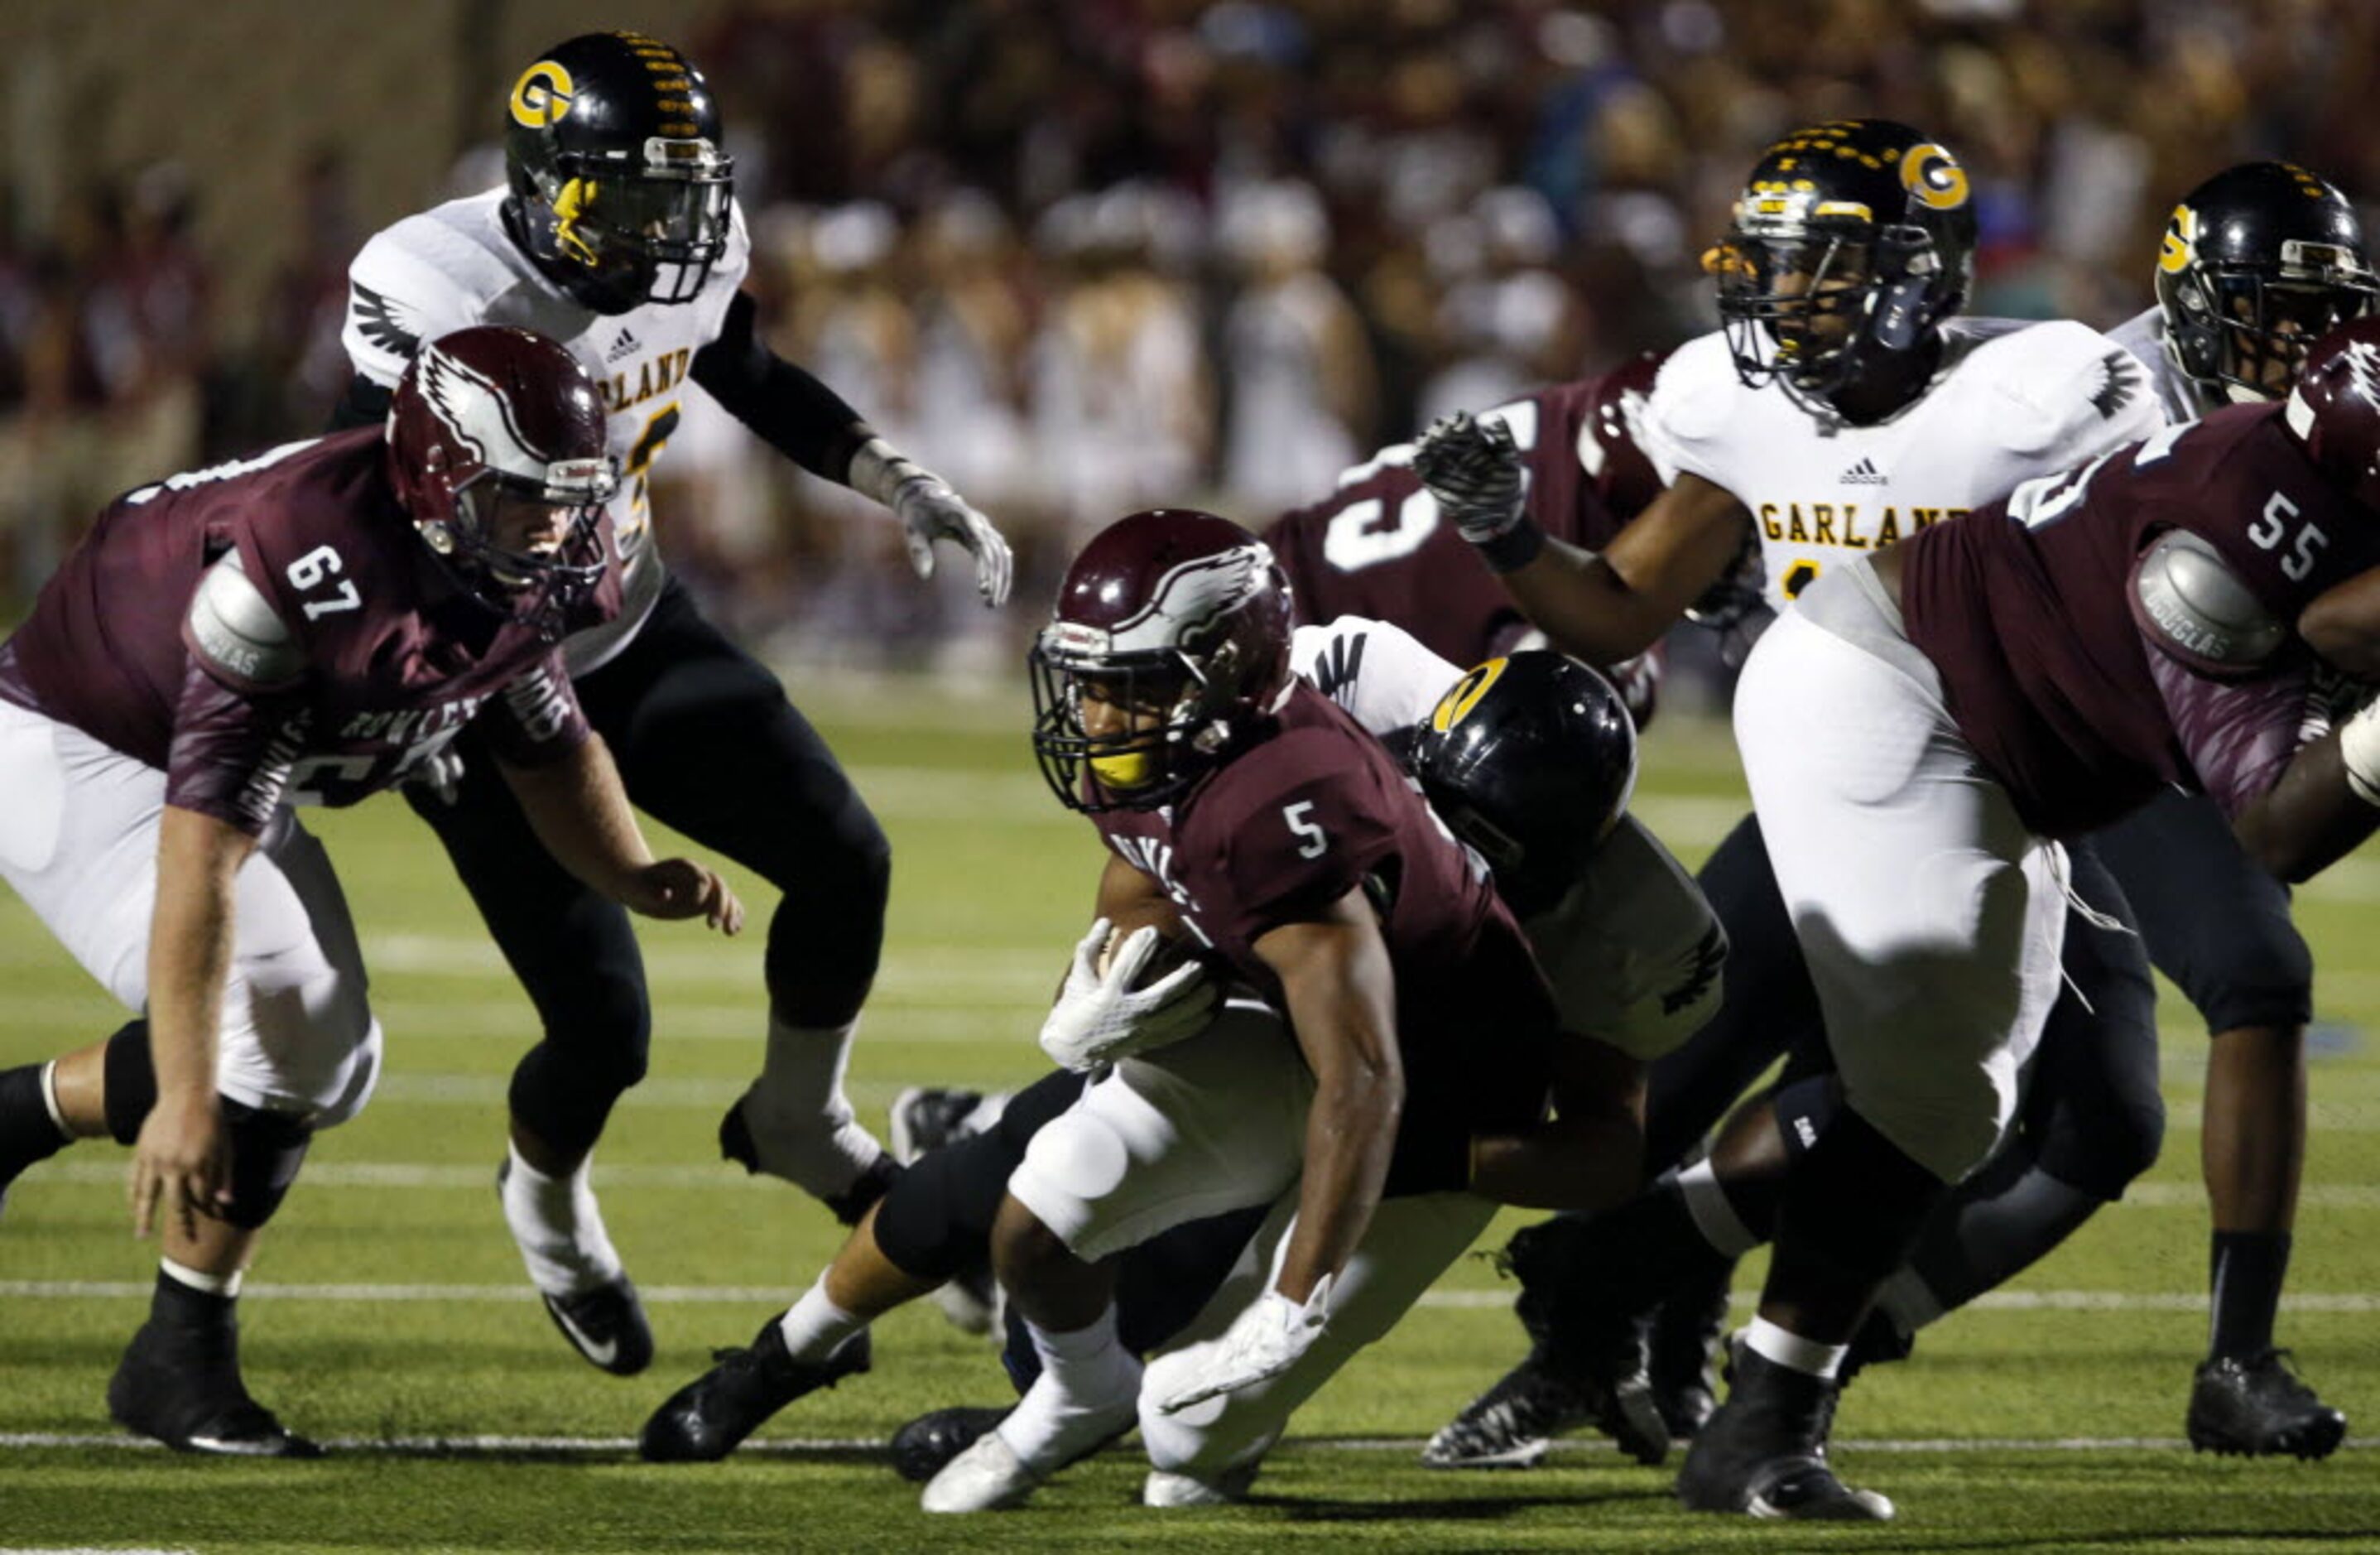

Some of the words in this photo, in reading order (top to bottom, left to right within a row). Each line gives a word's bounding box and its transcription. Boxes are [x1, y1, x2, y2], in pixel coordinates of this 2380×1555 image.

[511, 60, 573, 128] G
[1761, 503, 1975, 550] GARLA
[2248, 491, 2328, 582] 55
[287, 545, 363, 621] 67
[1283, 800, 1326, 859] 5
